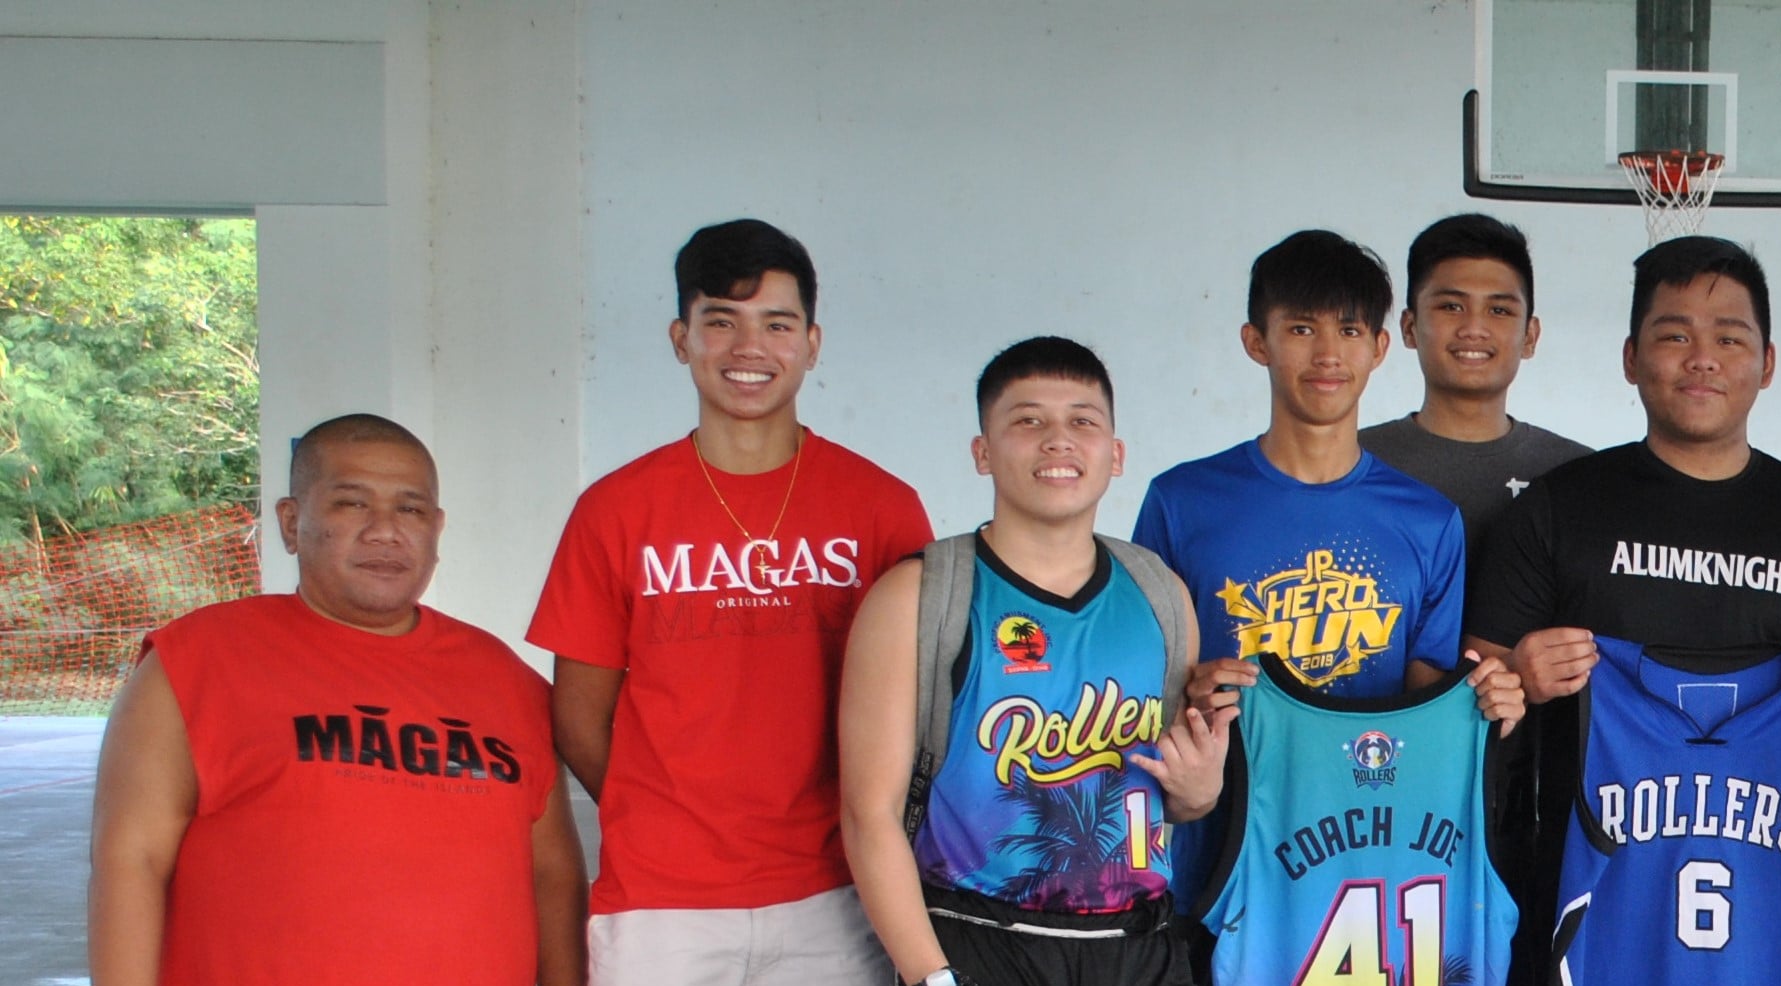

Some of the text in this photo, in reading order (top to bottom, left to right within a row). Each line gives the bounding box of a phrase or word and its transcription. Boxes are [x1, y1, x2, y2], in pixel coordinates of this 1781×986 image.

[642, 537, 859, 596] MAGAS
[1301, 549, 1334, 585] JP
[716, 595, 792, 609] ORIGINAL
[1265, 578, 1378, 623] HERO
[1237, 605, 1403, 661] RUN
[1353, 766, 1396, 786] ROLLERS
[1274, 806, 1464, 881] COACH JOE
[1675, 859, 1733, 951] 6
